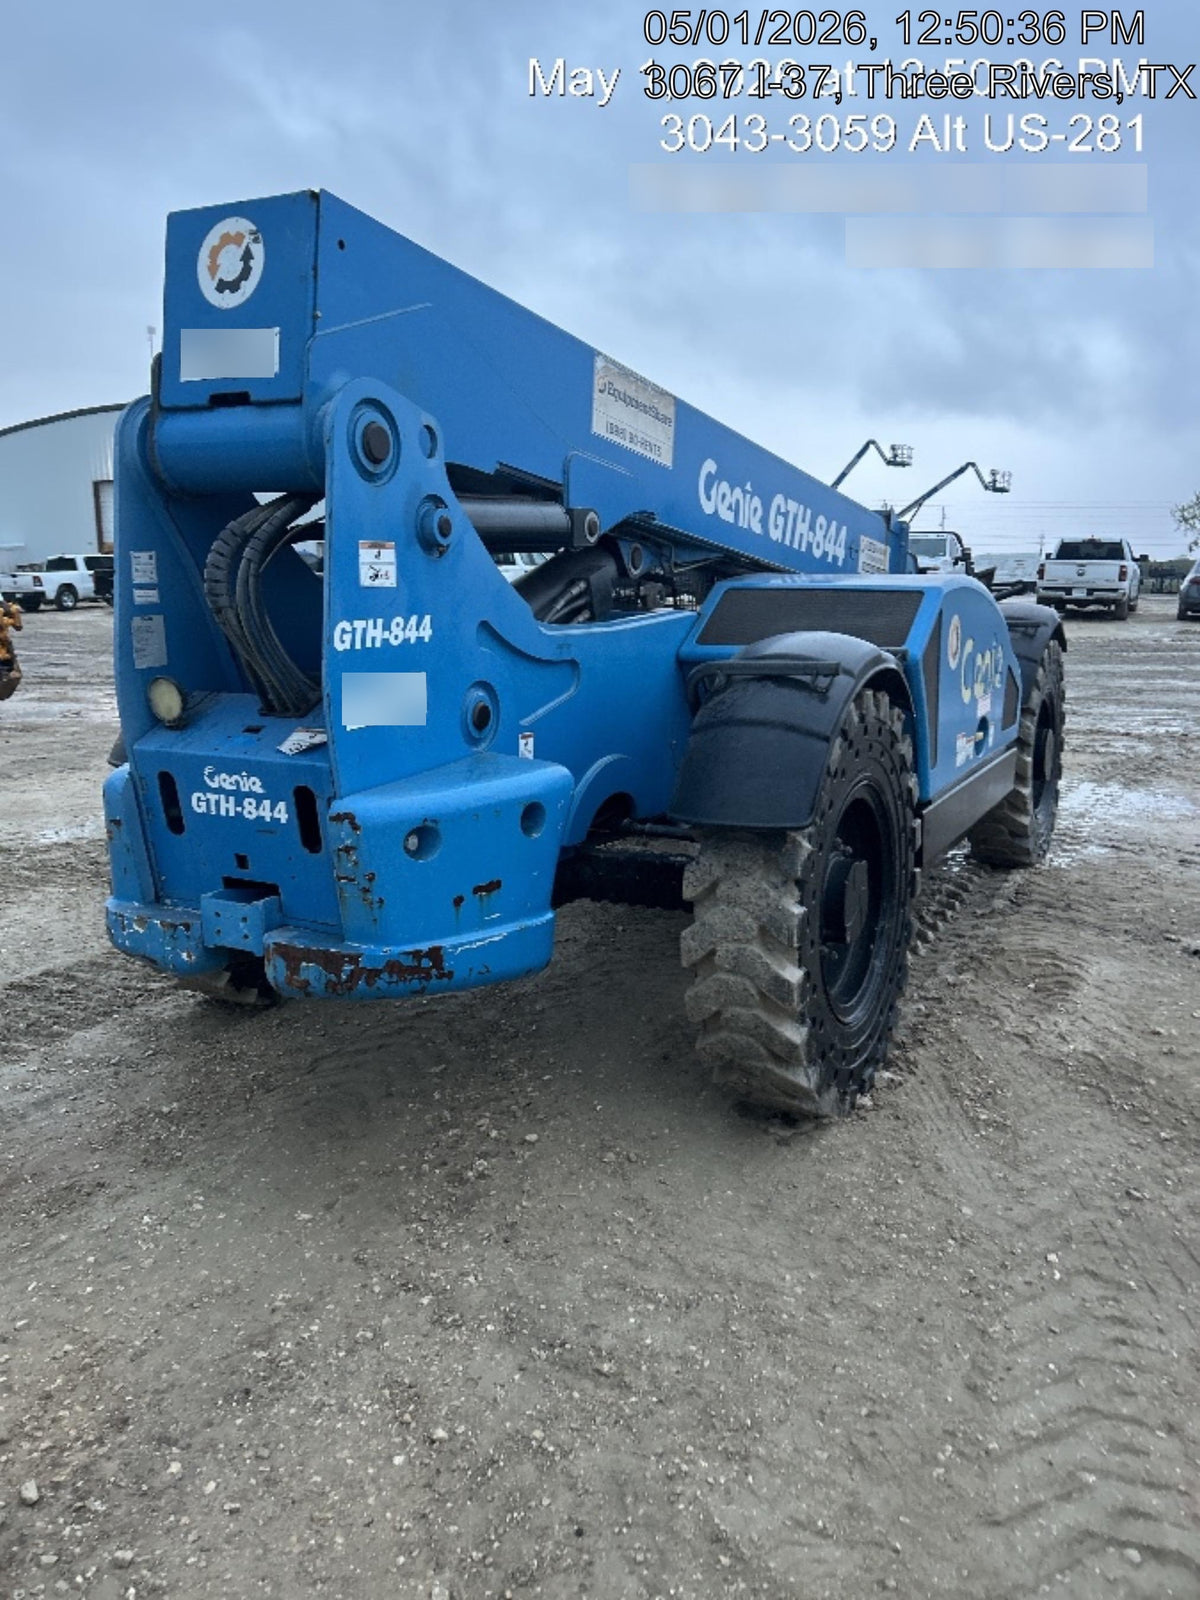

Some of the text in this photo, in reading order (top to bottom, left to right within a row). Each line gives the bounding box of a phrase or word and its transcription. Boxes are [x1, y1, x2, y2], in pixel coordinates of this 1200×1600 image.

[698, 458, 763, 535] Genie
[768, 493, 848, 567] GTH-844
[333, 614, 433, 652] GTH-844
[203, 765, 267, 794] Genie
[191, 792, 289, 824] GTH-844
